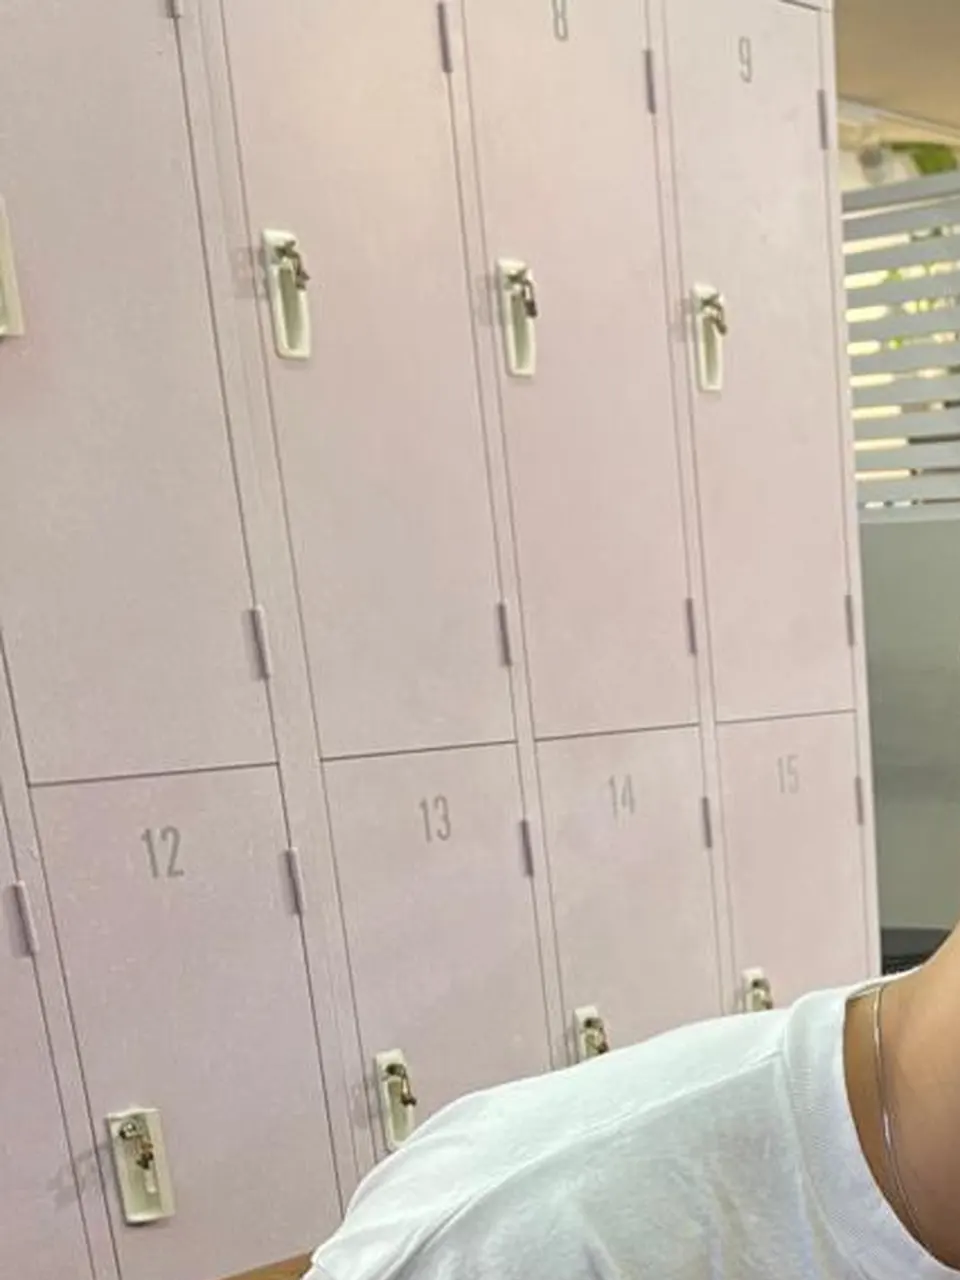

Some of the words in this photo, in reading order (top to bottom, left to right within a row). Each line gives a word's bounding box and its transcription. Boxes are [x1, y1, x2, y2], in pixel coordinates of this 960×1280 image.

[551, 0, 569, 41] 8
[737, 35, 753, 84] 9
[606, 772, 637, 818] 14
[776, 753, 800, 795] 15
[417, 793, 452, 843] 13
[141, 825, 185, 879] 12
